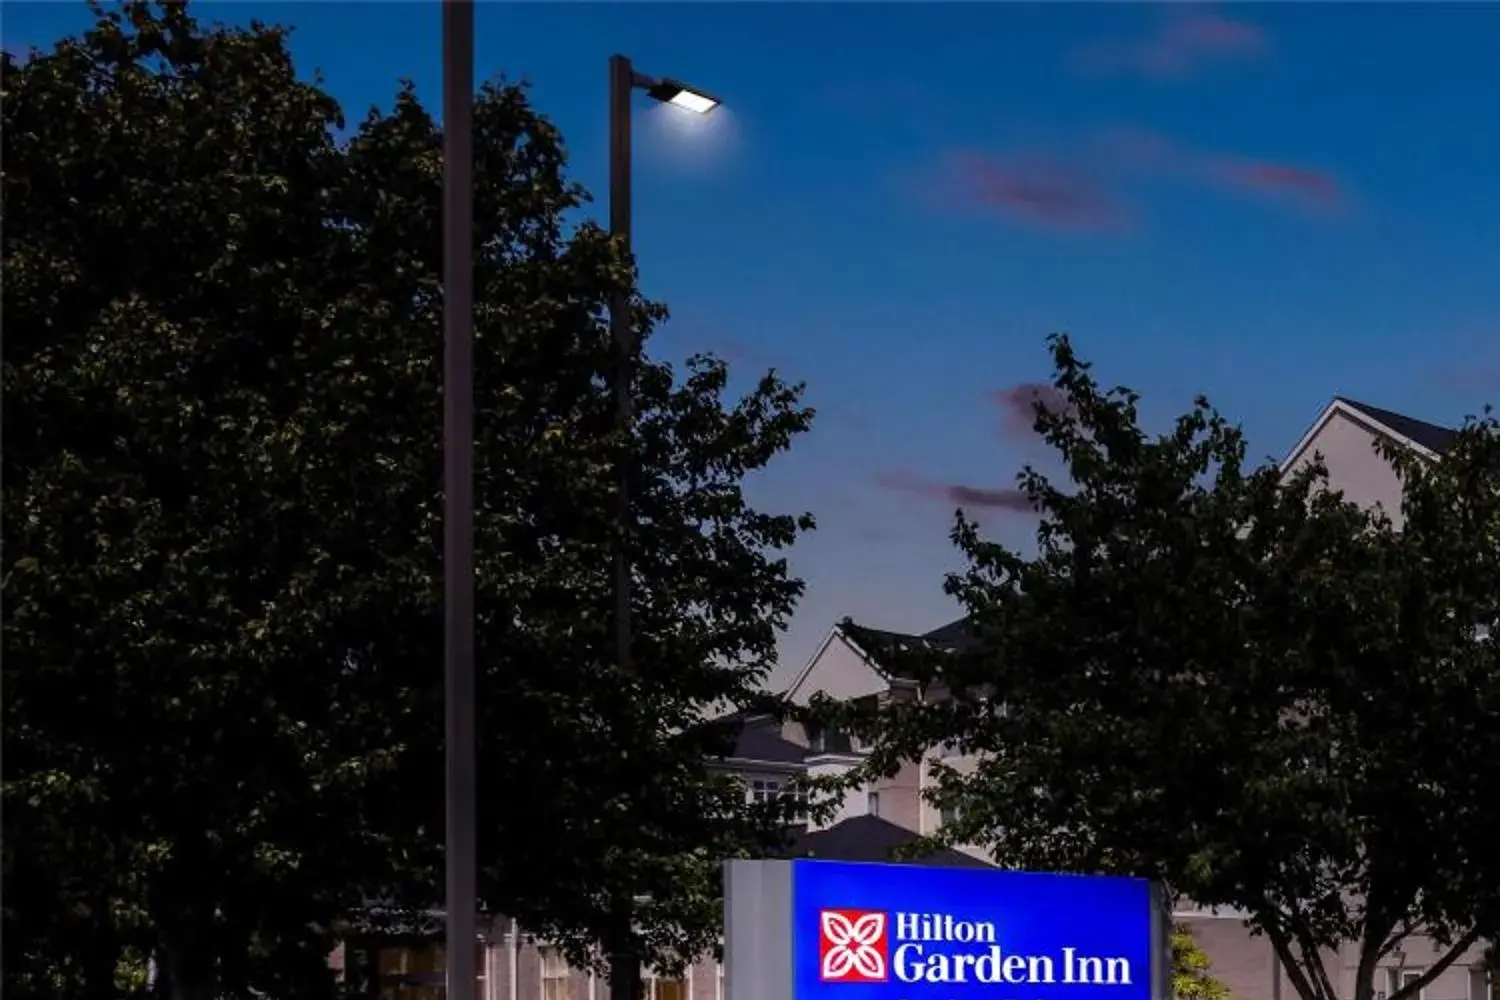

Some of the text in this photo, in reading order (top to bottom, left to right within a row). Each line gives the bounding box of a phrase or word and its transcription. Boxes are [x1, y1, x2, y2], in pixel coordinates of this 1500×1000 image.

[896, 912, 996, 943] Hilton
[893, 942, 1132, 985] Garden Inn
